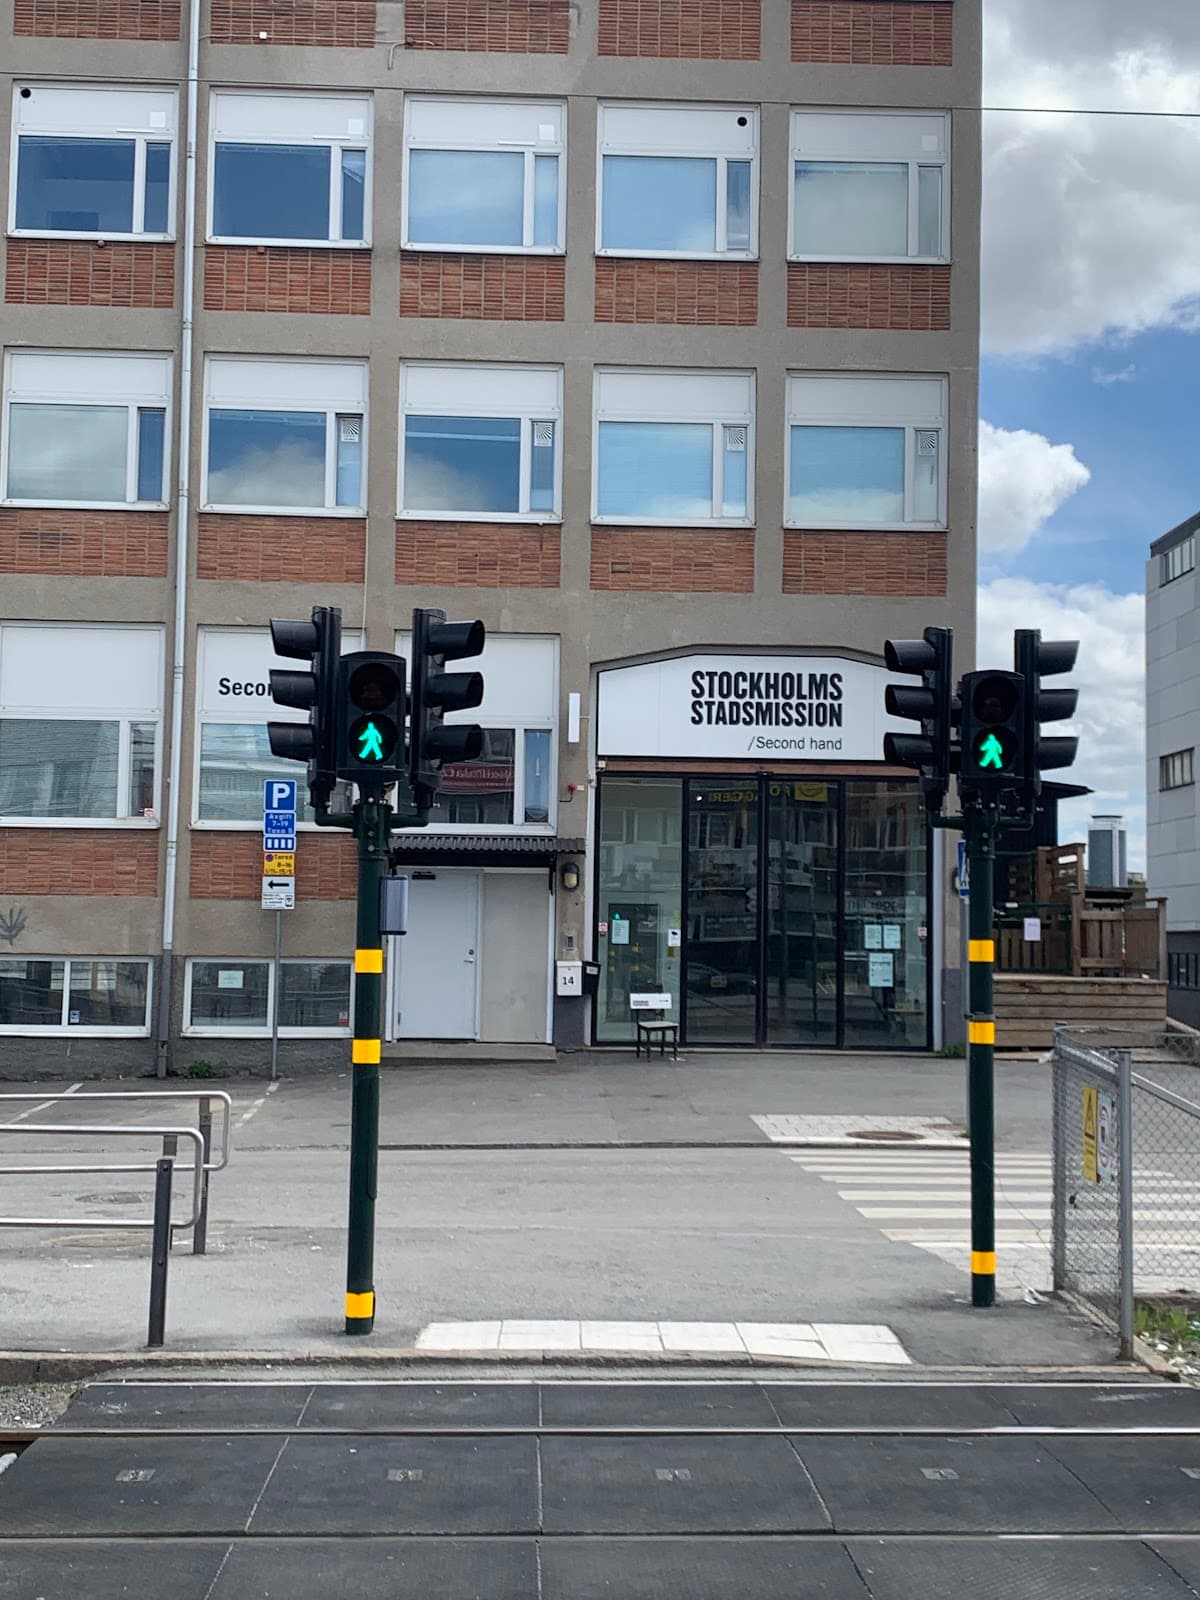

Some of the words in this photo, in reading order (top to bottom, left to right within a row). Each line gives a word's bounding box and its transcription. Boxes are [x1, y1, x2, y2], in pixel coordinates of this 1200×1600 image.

[691, 670, 843, 701] STOCKHOLMS
[691, 700, 843, 727] STADSMISSION
[810, 737, 843, 750] hand
[272, 783, 290, 808] P
[562, 976, 575, 985] 14
